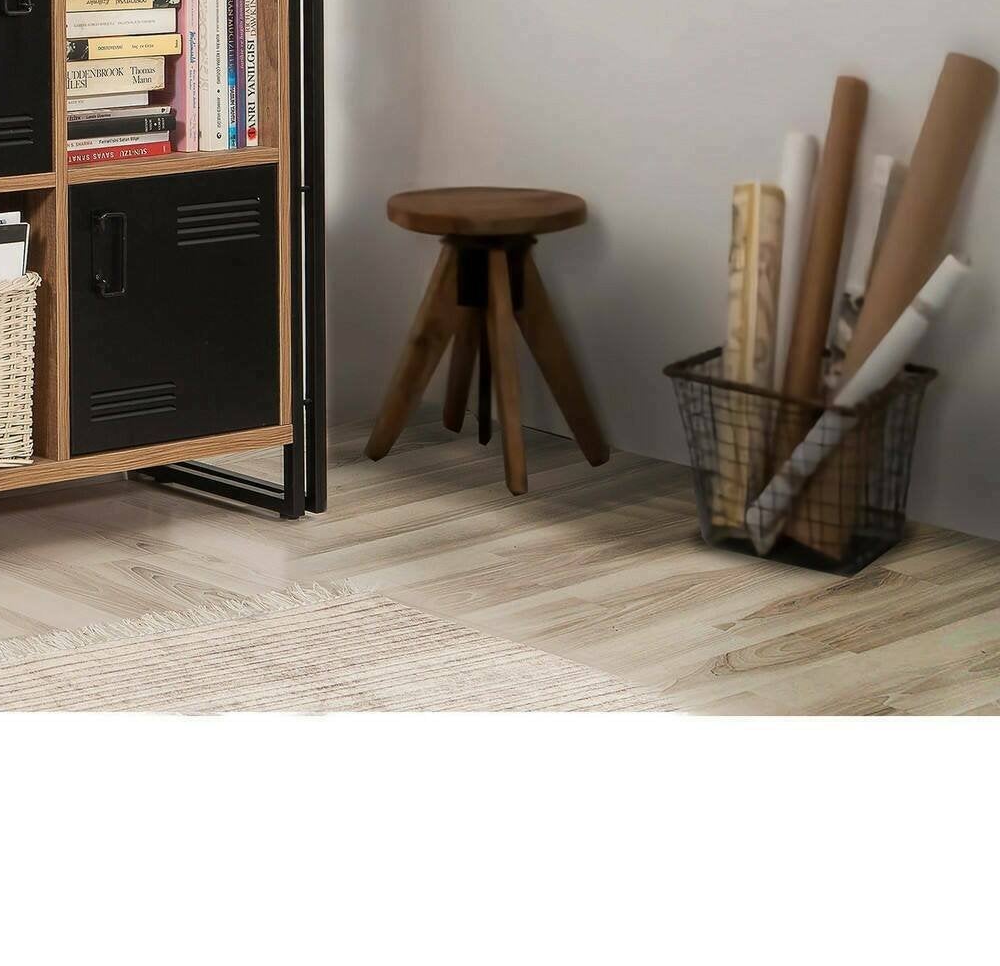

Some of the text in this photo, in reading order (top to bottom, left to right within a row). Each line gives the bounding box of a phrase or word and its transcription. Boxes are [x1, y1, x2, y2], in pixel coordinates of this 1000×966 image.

[66, 67, 124, 82] UDDENBROOK
[130, 66, 156, 77] Thomas
[132, 75, 152, 84] Mann
[246, 39, 256, 138] TANRI YANILGISI
[68, 154, 90, 163] SANAT
